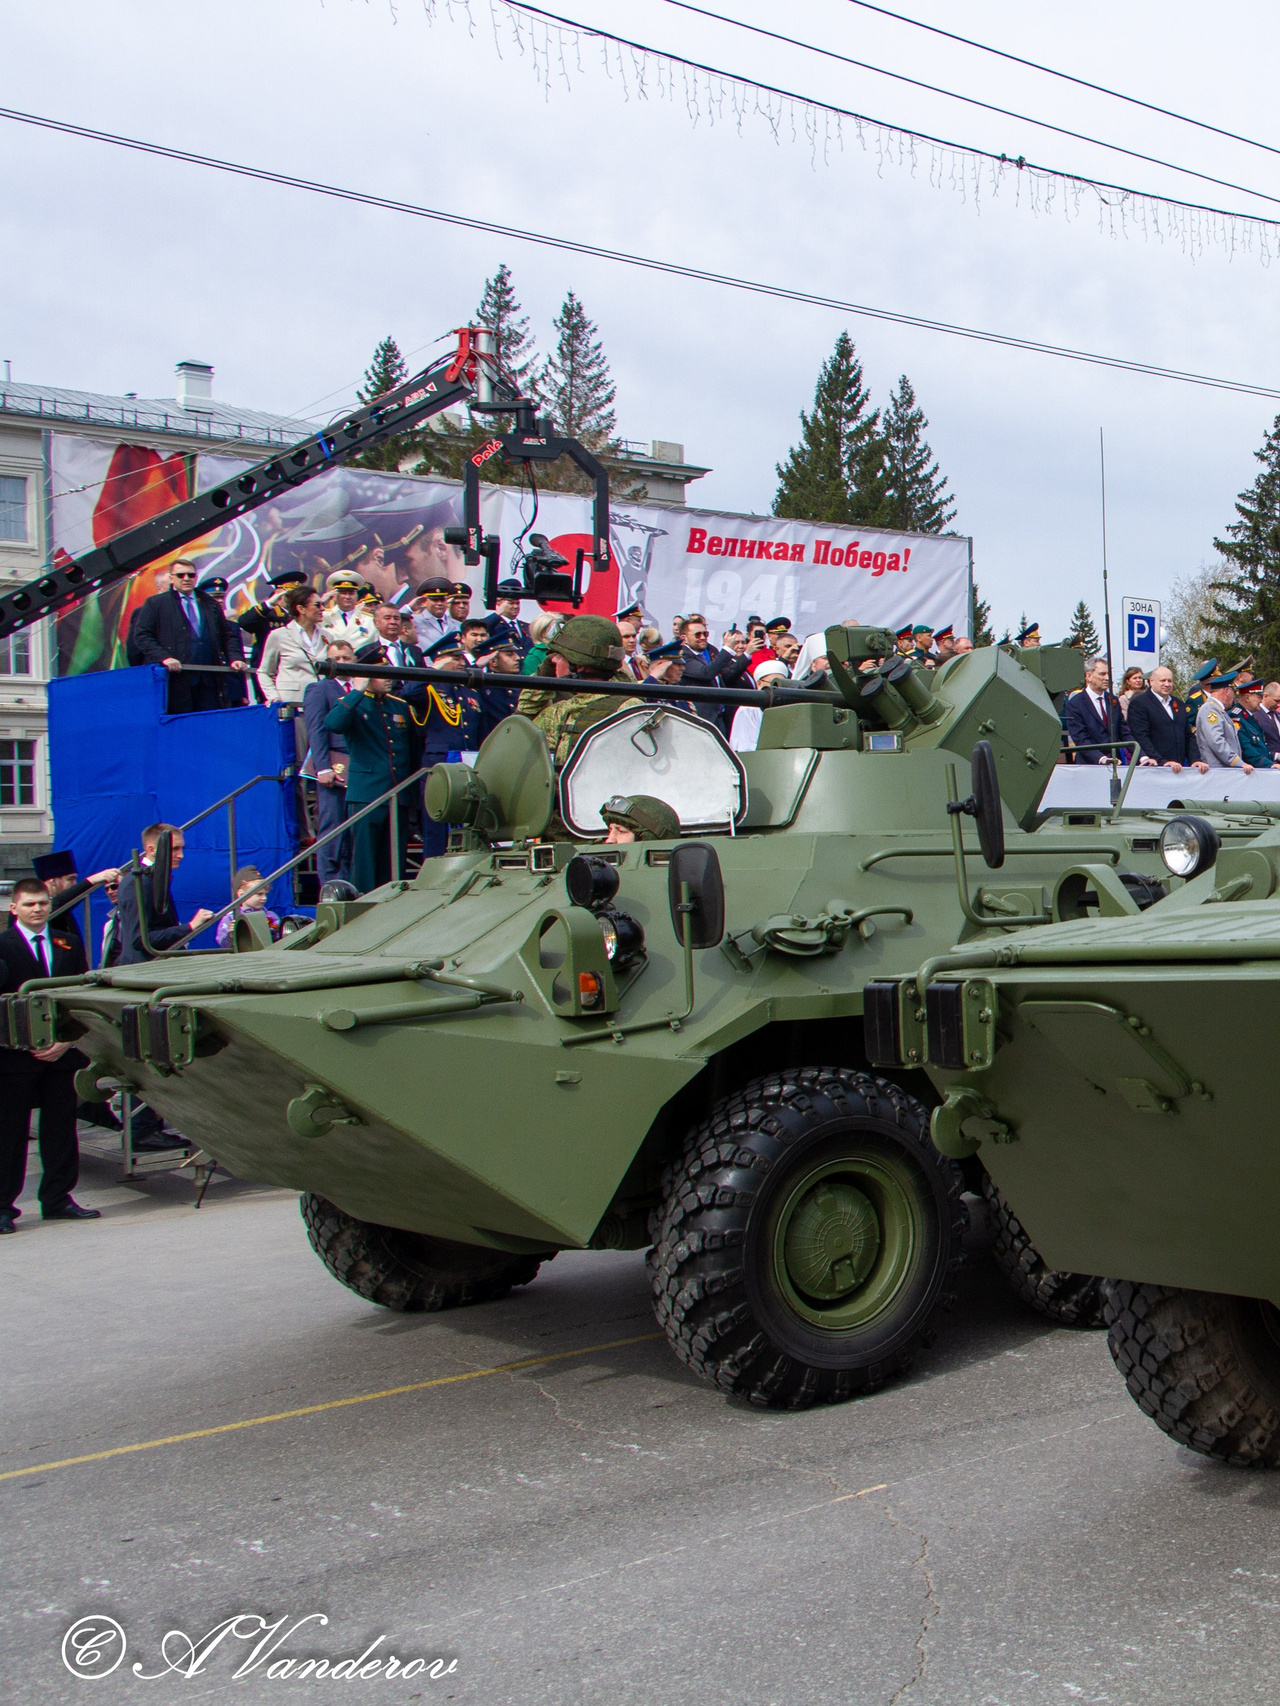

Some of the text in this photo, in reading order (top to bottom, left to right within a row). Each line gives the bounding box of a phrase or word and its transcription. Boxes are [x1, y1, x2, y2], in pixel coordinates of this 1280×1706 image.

[686, 527, 911, 577] Великая Победа!
[1130, 602, 1154, 613] ЗОНА
[1133, 618, 1150, 648] P
